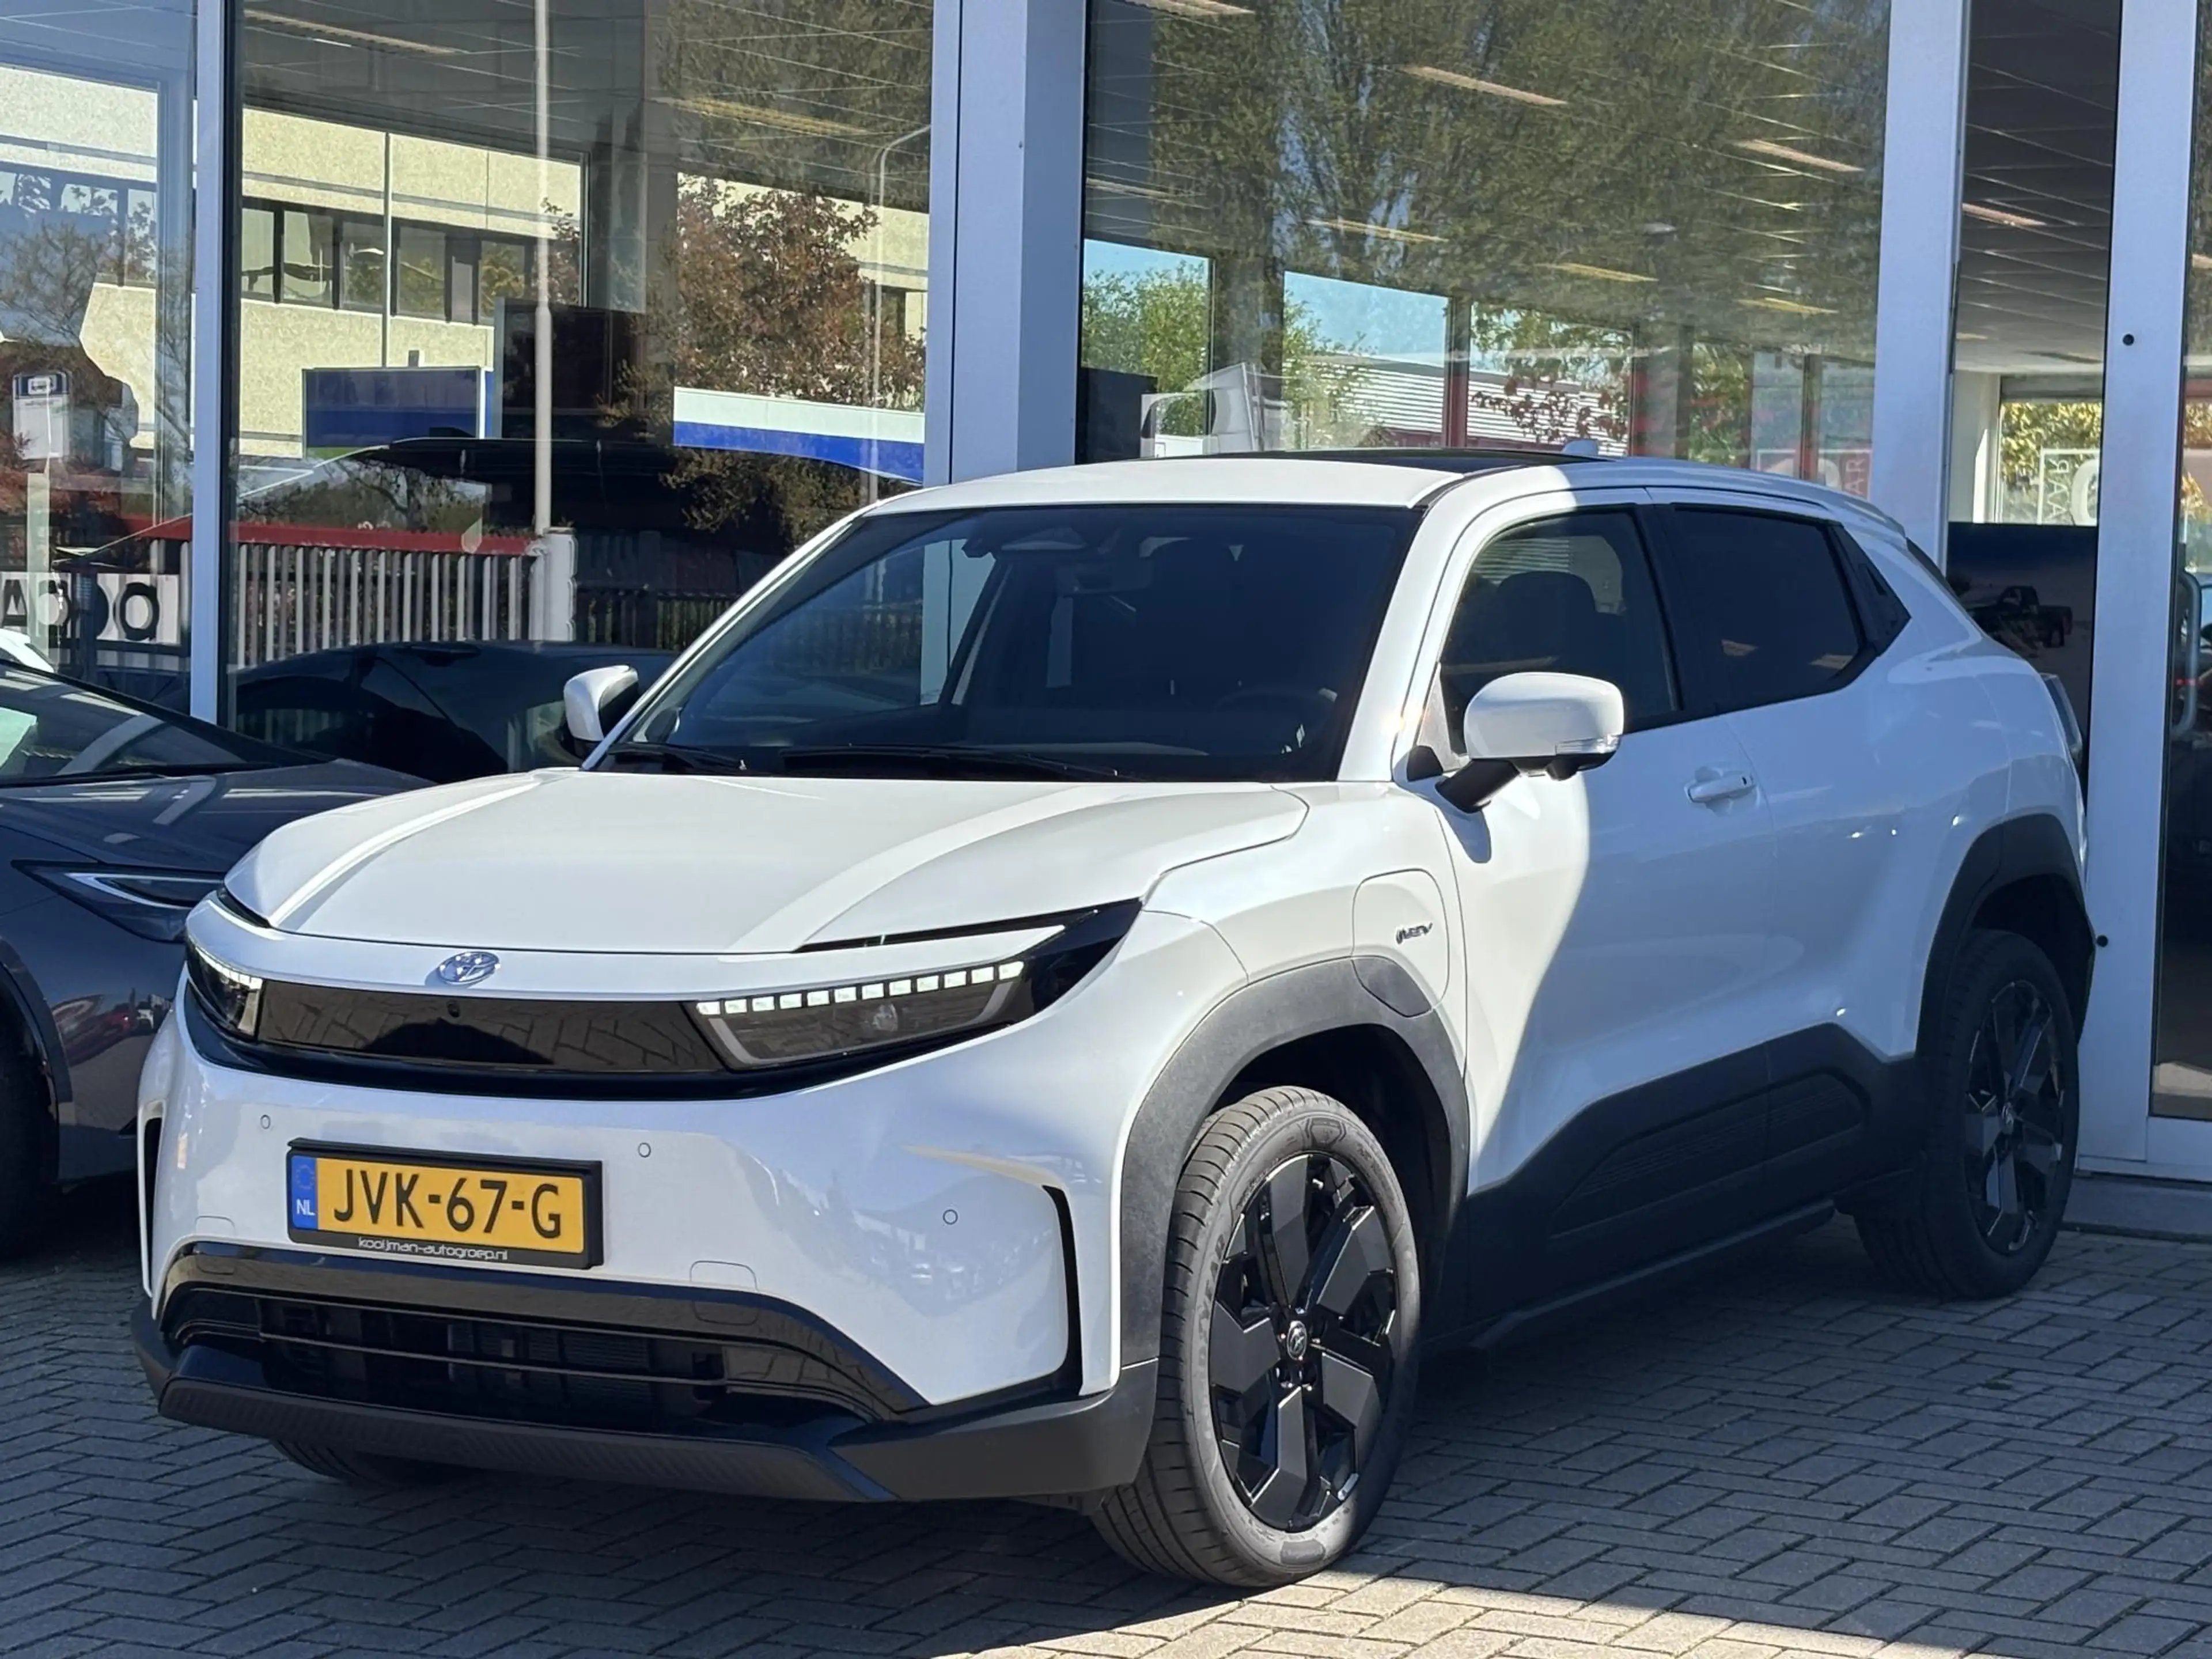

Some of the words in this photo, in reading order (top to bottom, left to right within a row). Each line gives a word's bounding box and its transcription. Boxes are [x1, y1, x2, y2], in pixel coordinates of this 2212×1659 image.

[296, 1199, 315, 1216] NL
[334, 1169, 561, 1238] JVK-67-G
[358, 1236, 507, 1260] kooijman-autogroep.nl
